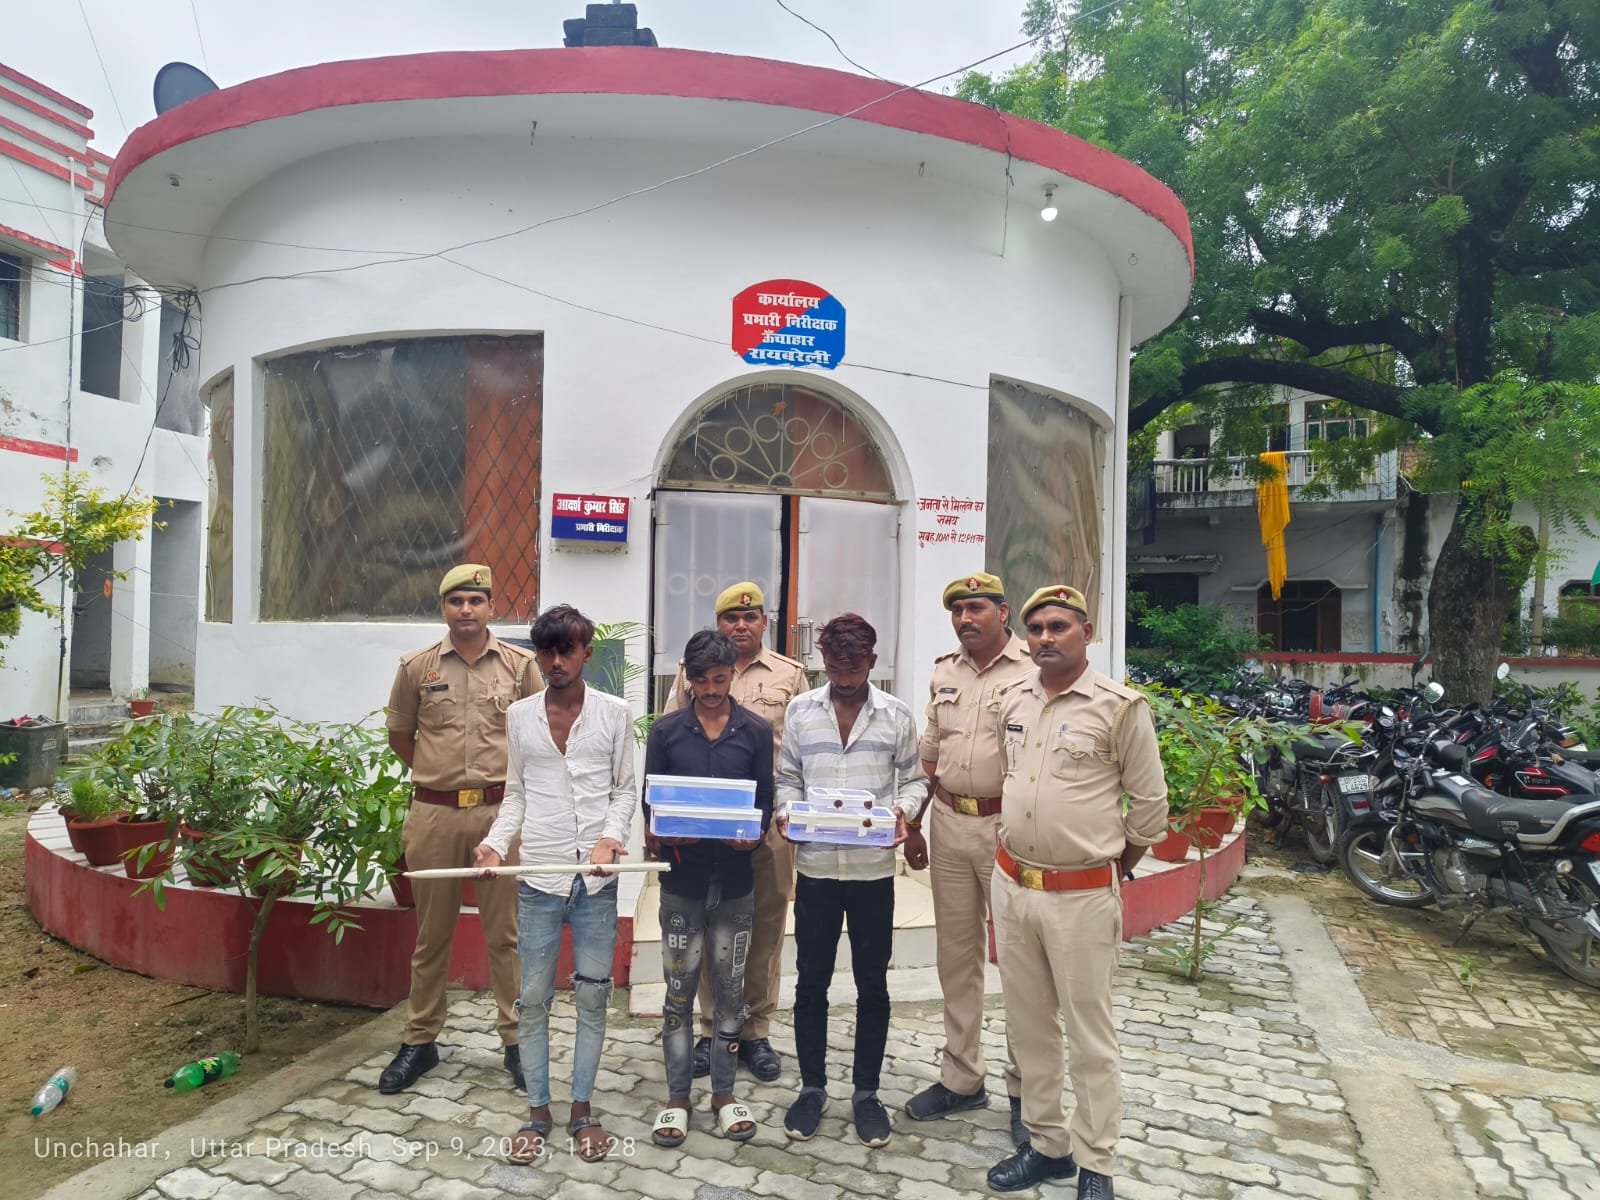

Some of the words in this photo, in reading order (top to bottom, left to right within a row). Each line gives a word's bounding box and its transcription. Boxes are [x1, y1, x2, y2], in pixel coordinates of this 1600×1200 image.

[757, 292, 821, 309] कार्यालय
[785, 313, 839, 331] निरीक्षक
[747, 348, 831, 364] रायबरेली
[584, 500, 608, 515] कुमार
[917, 497, 941, 511] जनता
[936, 514, 960, 526] समय
[668, 933, 688, 949] BE
